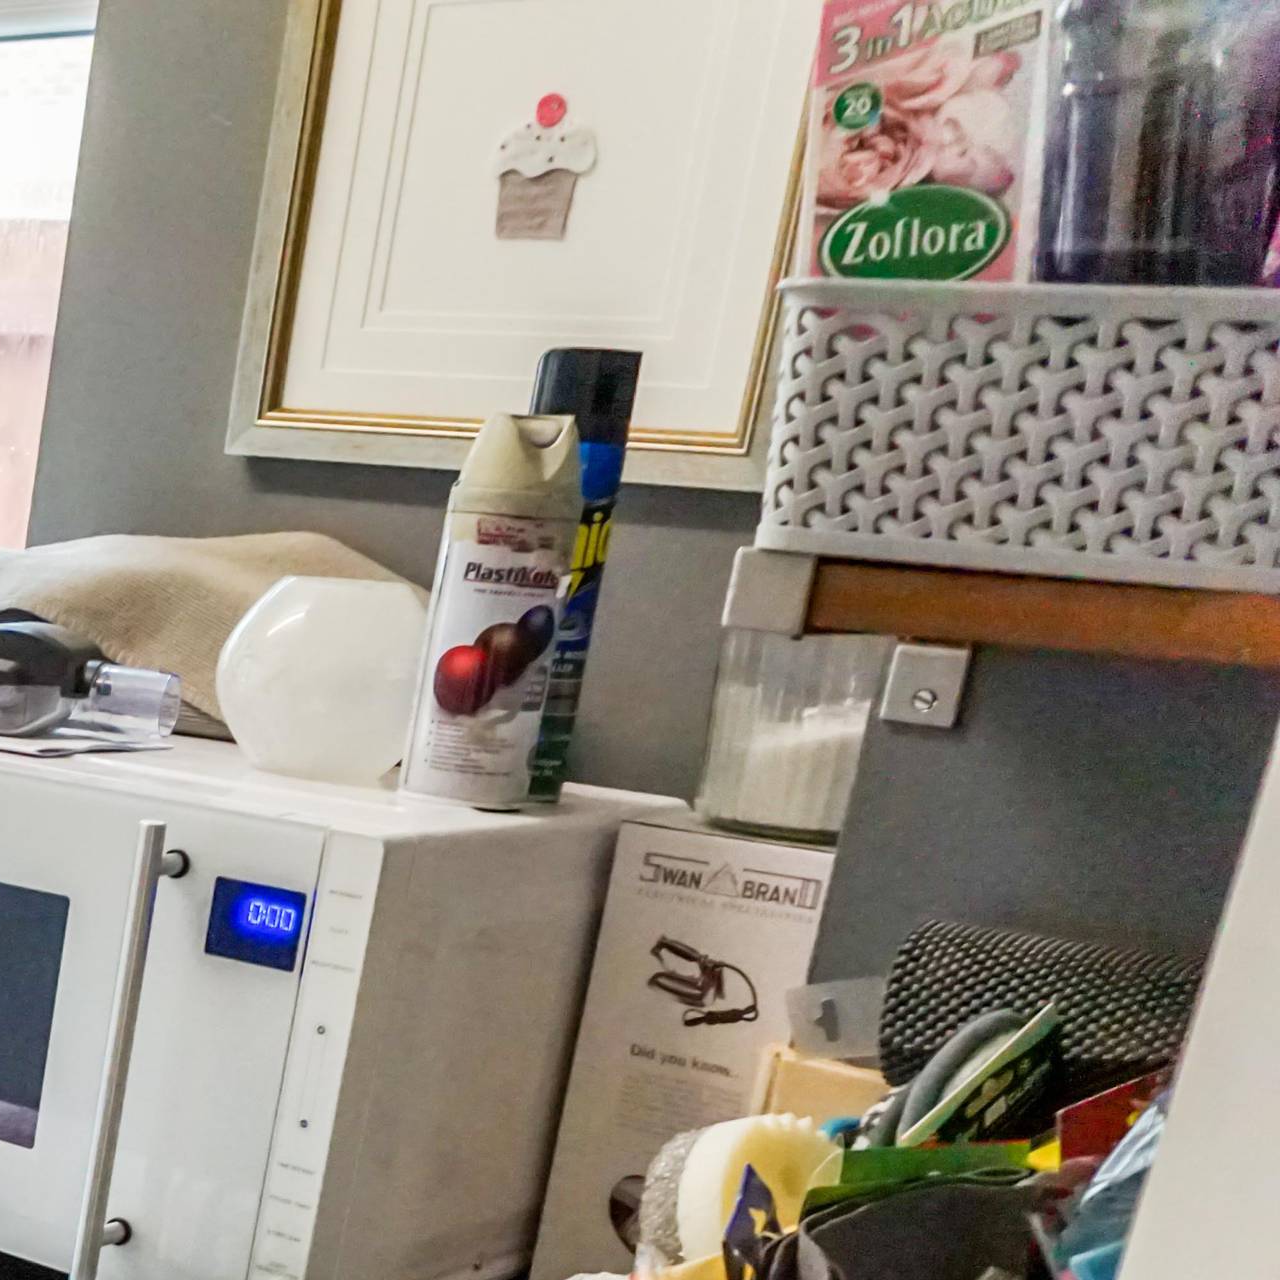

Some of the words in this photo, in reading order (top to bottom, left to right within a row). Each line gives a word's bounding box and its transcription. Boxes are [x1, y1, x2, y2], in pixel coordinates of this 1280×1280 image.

[828, 25, 862, 75] 3
[892, 3, 914, 48] 1
[843, 97, 873, 116] 20
[840, 218, 988, 265] Zoflora
[246, 900, 295, 932] 0:00
[630, 1043, 656, 1060] Did
[660, 1053, 687, 1068] you
